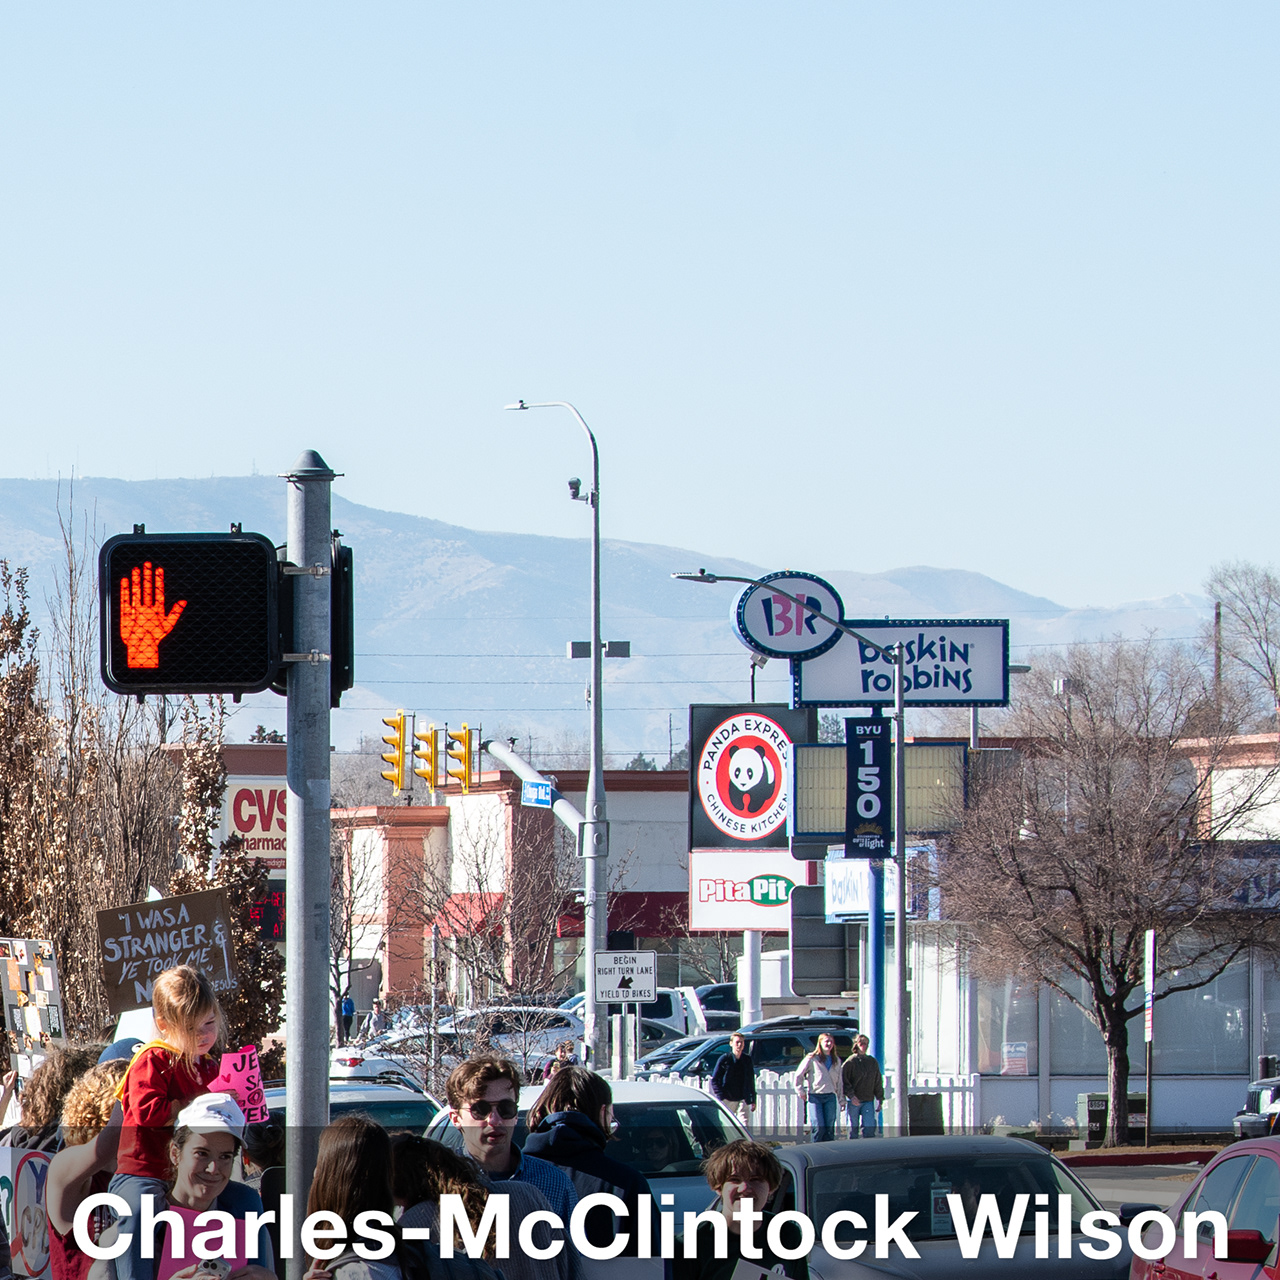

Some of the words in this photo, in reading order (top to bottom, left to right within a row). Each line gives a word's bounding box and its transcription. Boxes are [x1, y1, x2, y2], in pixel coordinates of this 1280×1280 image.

[855, 725, 882, 735] BYU
[703, 723, 740, 770] PANDA
[856, 740, 881, 819] 150
[707, 794, 746, 833] CHINESE
[865, 839, 884, 849] light
[136, 907, 176, 931] WAS
[176, 902, 190, 925] A
[117, 960, 143, 985] YE
[144, 952, 183, 977] TOOK
[614, 955, 637, 965] BEGIN
[597, 966, 615, 976] RIGHT
[618, 966, 634, 975] TURN
[637, 966, 653, 975] LANE
[600, 990, 620, 999] YIELD
[622, 990, 631, 998] TO
[632, 989, 652, 998] BIKES
